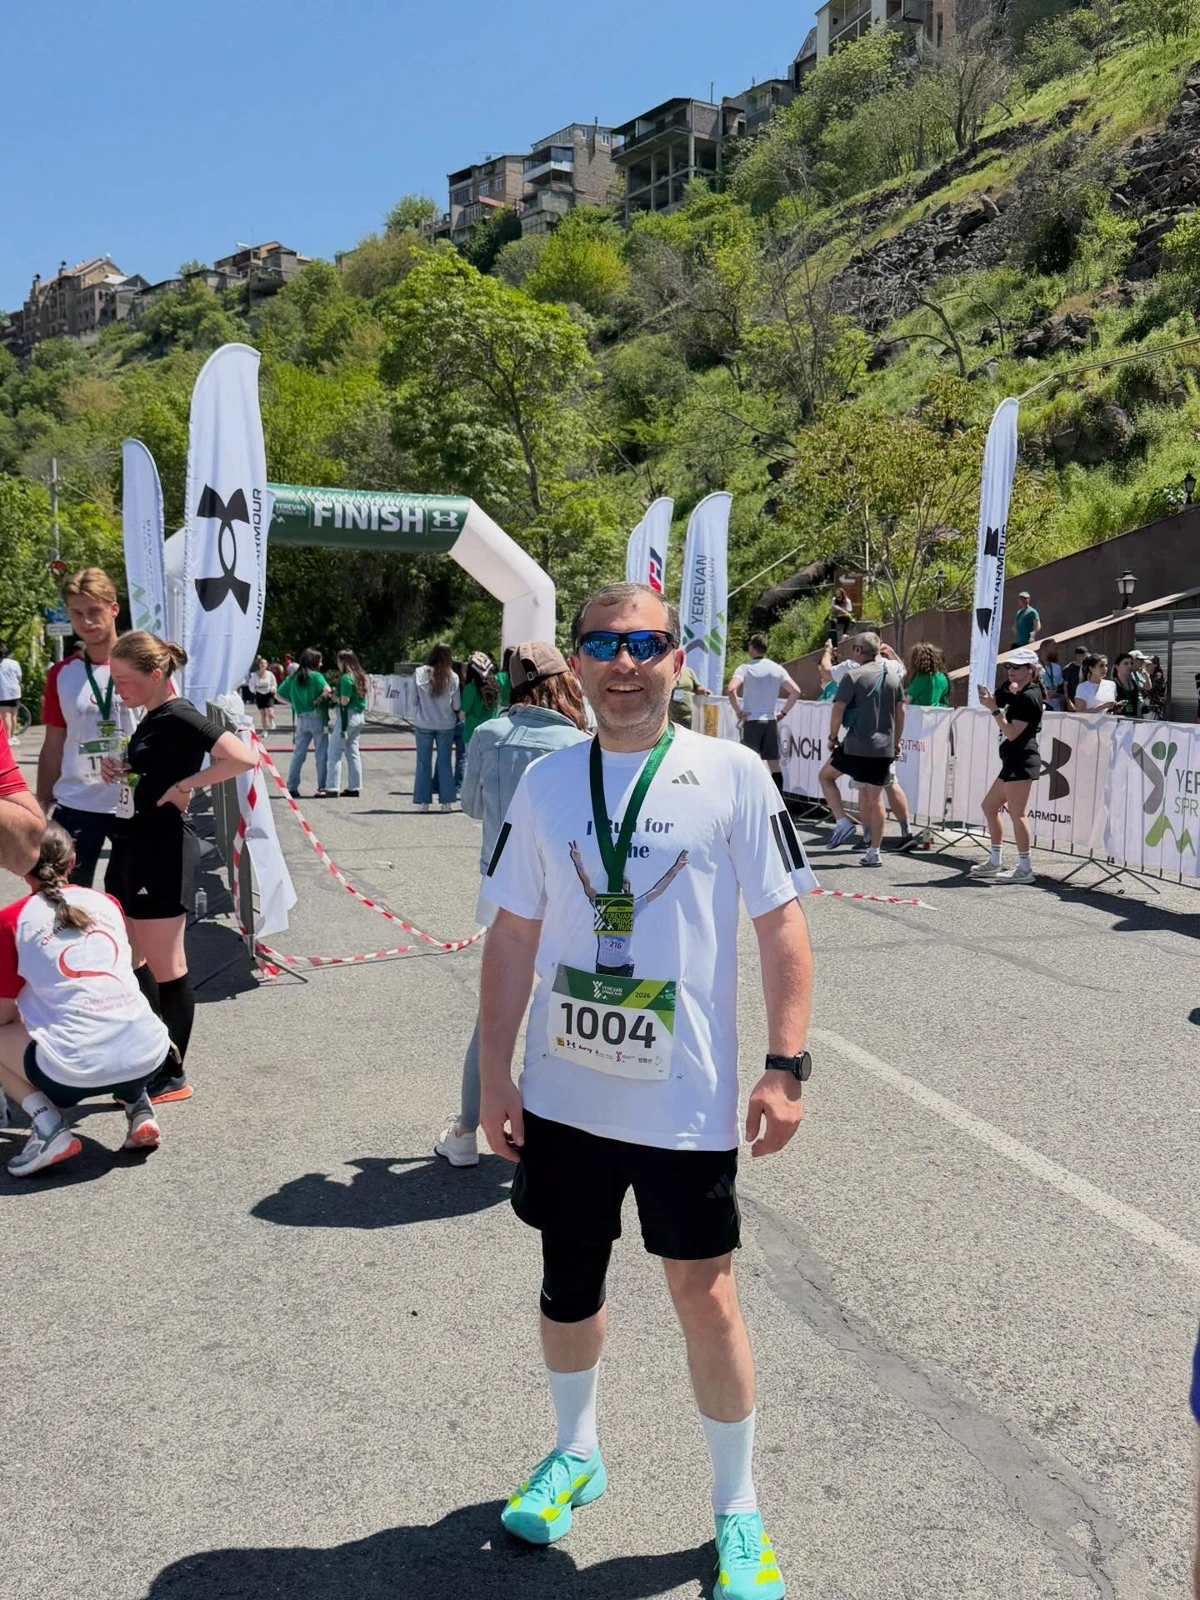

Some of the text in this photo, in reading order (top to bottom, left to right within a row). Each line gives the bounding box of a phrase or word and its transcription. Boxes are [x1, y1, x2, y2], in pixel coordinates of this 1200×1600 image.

[313, 500, 423, 533] FINISH
[691, 554, 707, 625] YEREVAN
[644, 818, 674, 834] for
[1027, 809, 1072, 825] ARMOUR
[602, 912, 633, 920] YEREVAN
[560, 1001, 656, 1049] 1004
